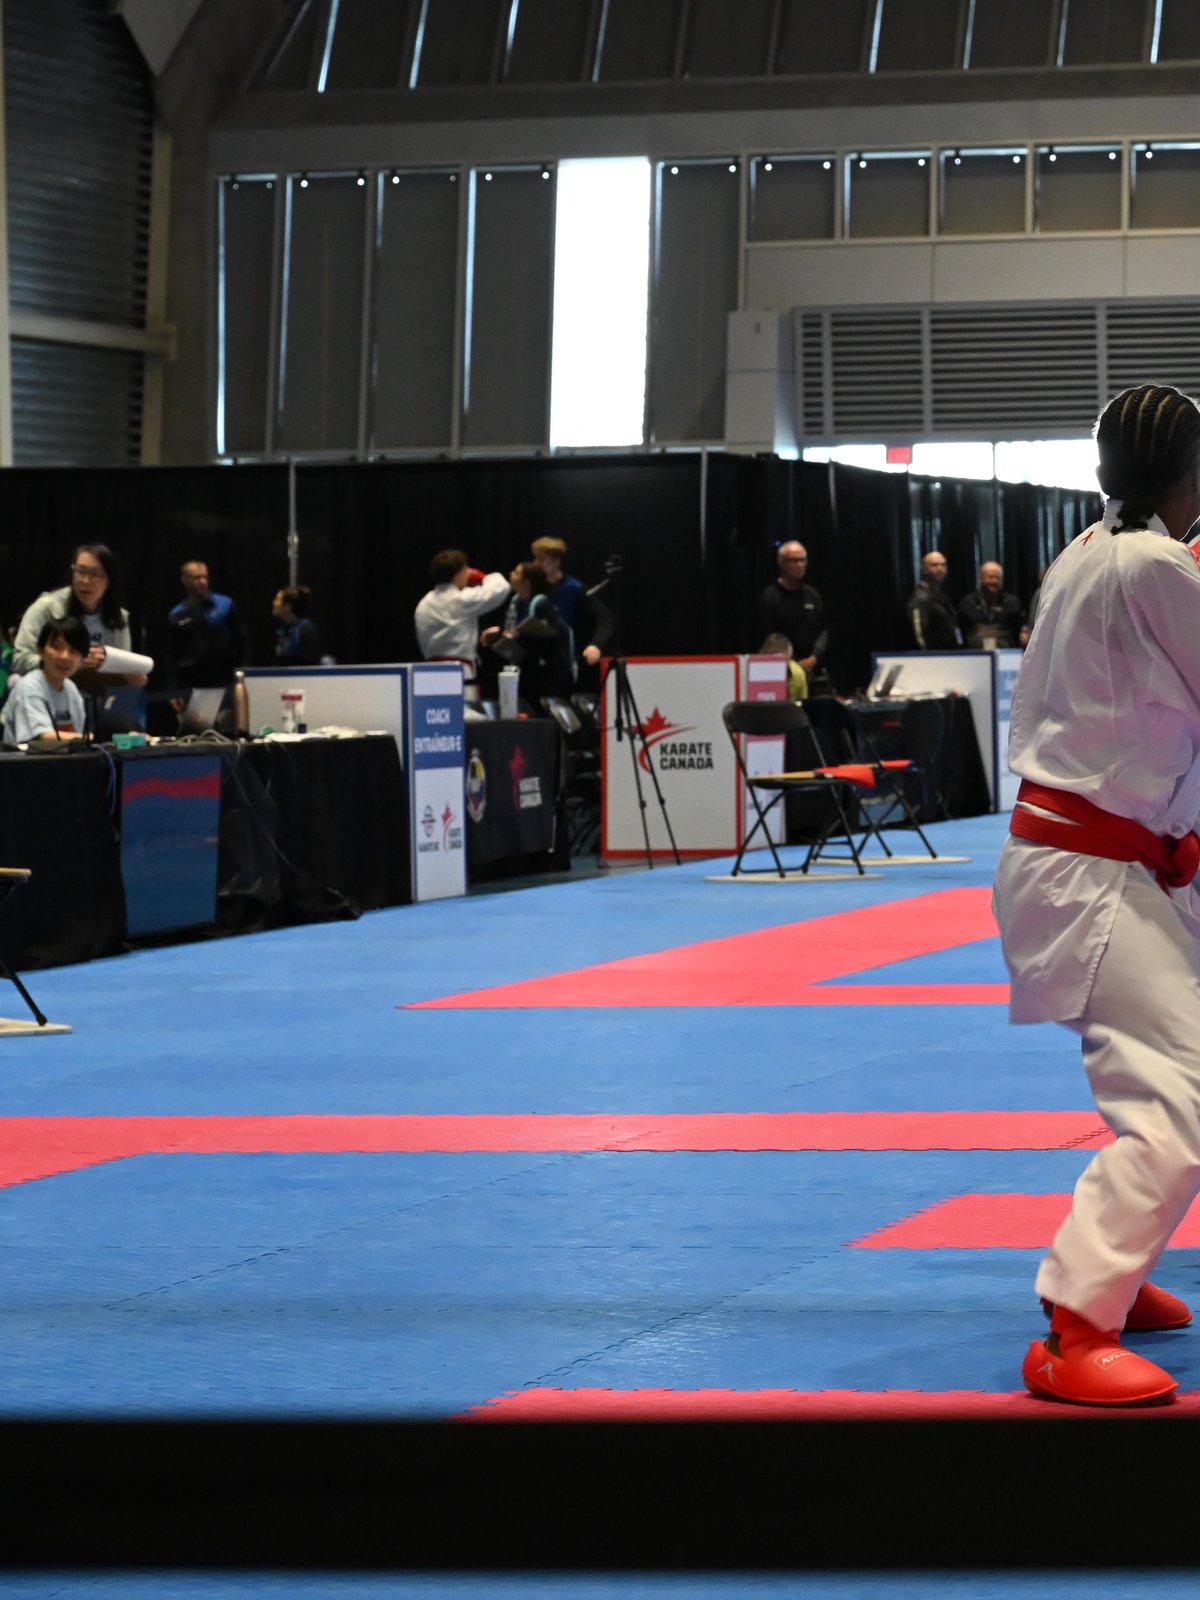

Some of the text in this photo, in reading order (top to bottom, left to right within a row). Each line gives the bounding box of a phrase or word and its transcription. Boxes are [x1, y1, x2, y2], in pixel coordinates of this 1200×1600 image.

[426, 708, 450, 724] COACH
[660, 742, 712, 756] KARATE
[660, 757, 714, 770] CANADA
